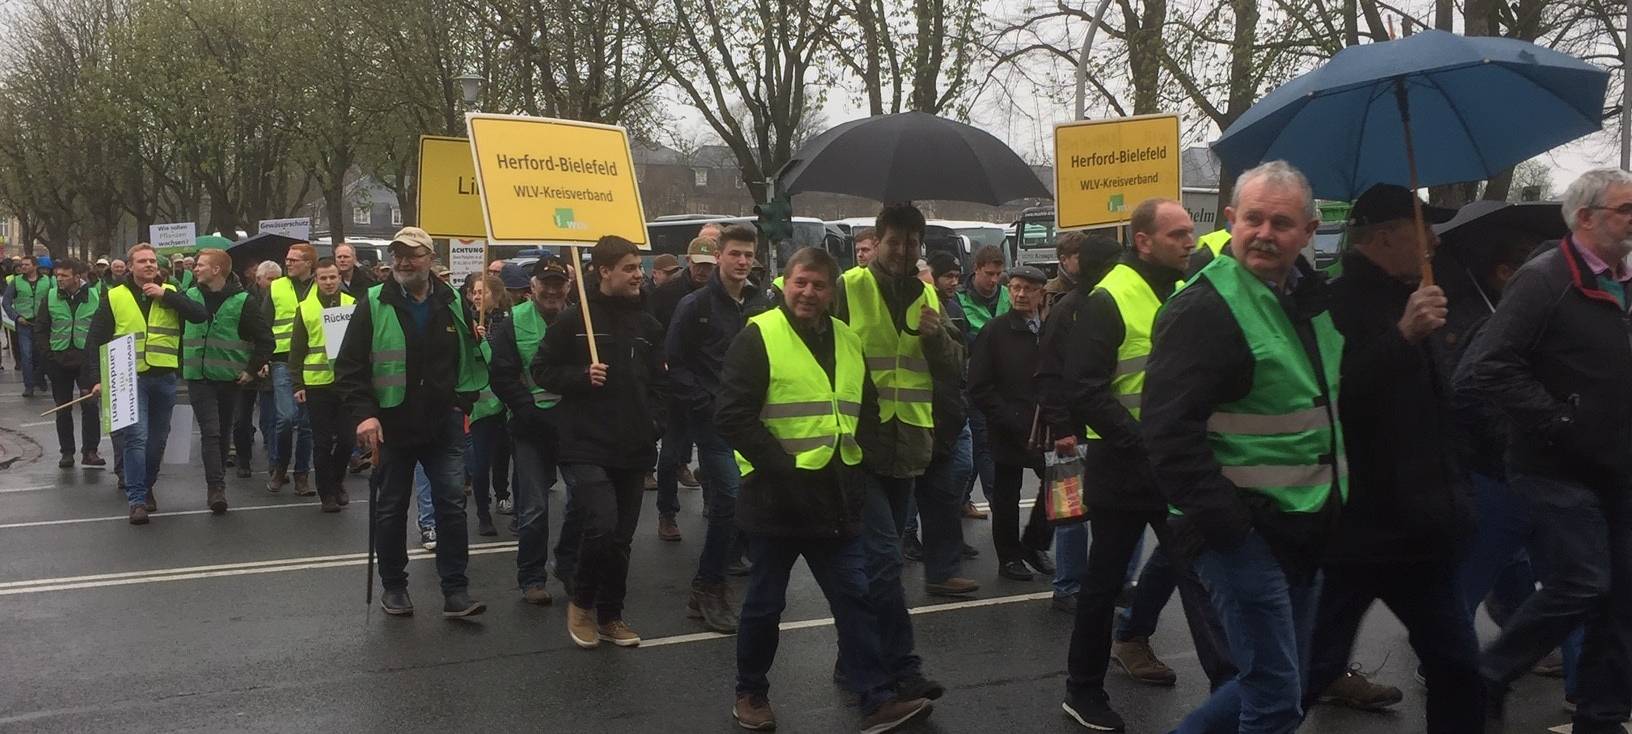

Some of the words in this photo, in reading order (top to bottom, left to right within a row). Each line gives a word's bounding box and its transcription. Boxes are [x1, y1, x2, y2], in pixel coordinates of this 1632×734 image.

[497, 154, 618, 176] Herford-Bielefeld
[1071, 145, 1167, 168] Herford-Bielefeld
[1080, 173, 1158, 190] WLV-Kreisverband
[513, 185, 614, 202] WLV-Kreisverband
[158, 239, 189, 247] wachsen?
[324, 312, 353, 324] Rücke
[110, 347, 119, 423] Landwirten!
[126, 335, 135, 422] Gewässerschutz
